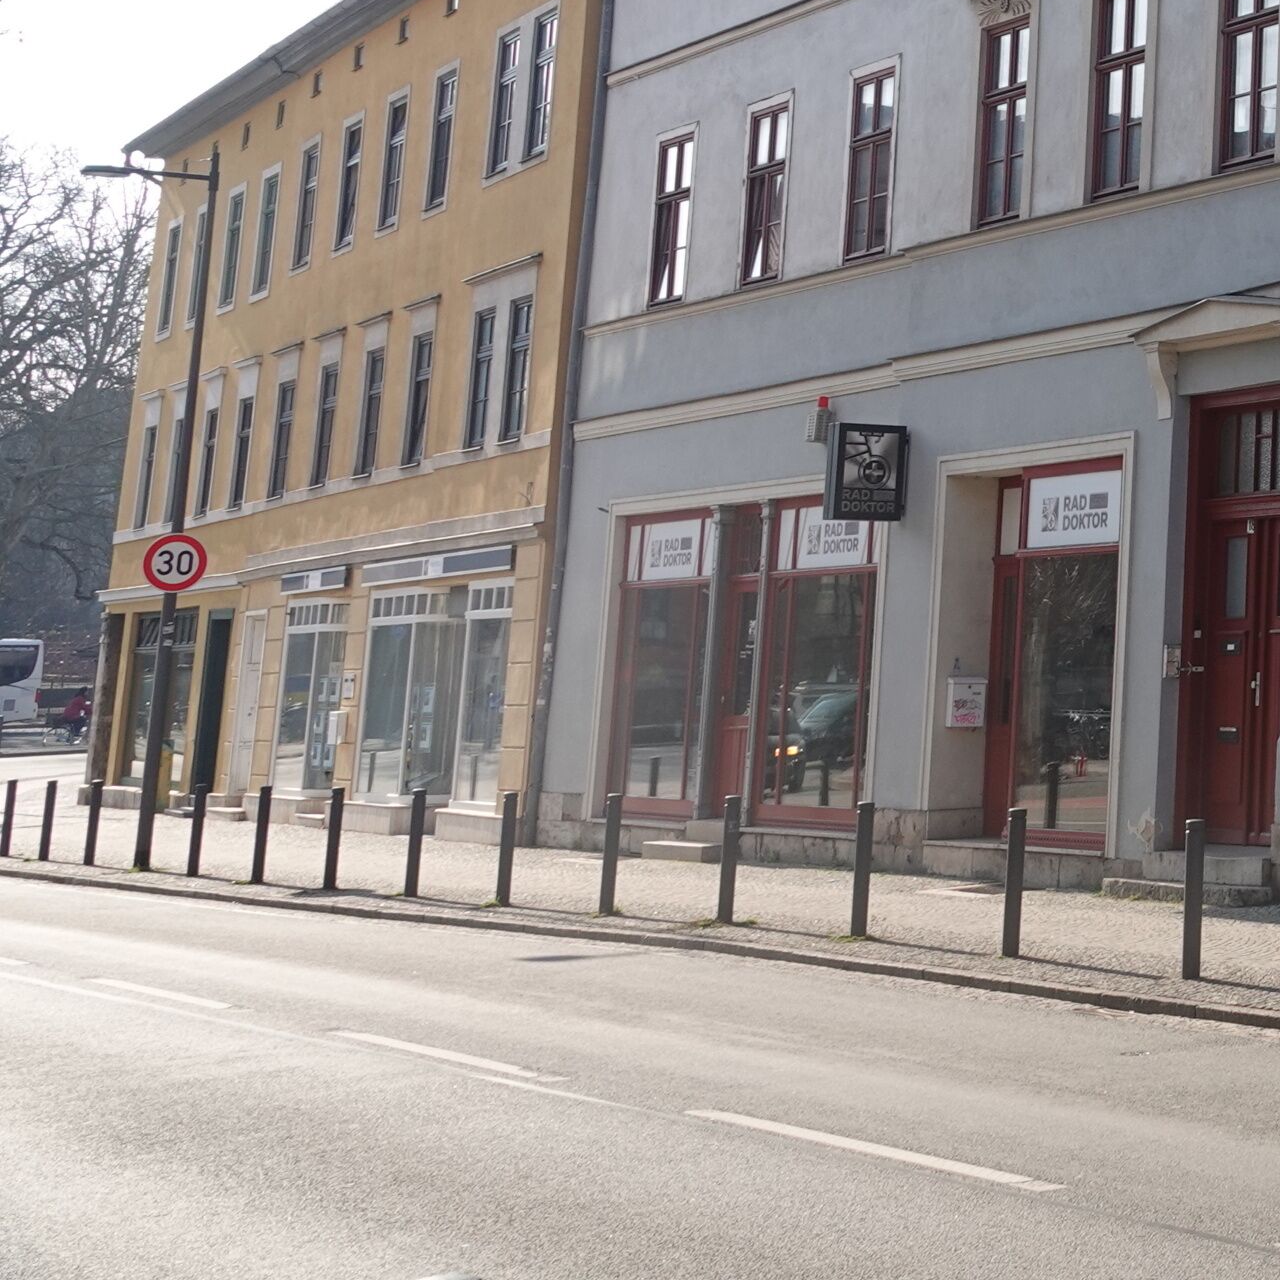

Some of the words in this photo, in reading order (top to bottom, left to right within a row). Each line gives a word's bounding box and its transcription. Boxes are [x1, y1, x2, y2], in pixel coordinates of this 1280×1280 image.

[841, 489, 871, 500] RAD
[841, 501, 895, 513] DOKTOR
[1063, 494, 1088, 512] RAD
[824, 521, 844, 537] RAD
[1062, 511, 1108, 531] DOKTOR
[664, 538, 680, 552] RAD
[822, 538, 859, 555] DOKTOR
[156, 550, 194, 576] 30
[662, 552, 692, 567] DOKTOR
